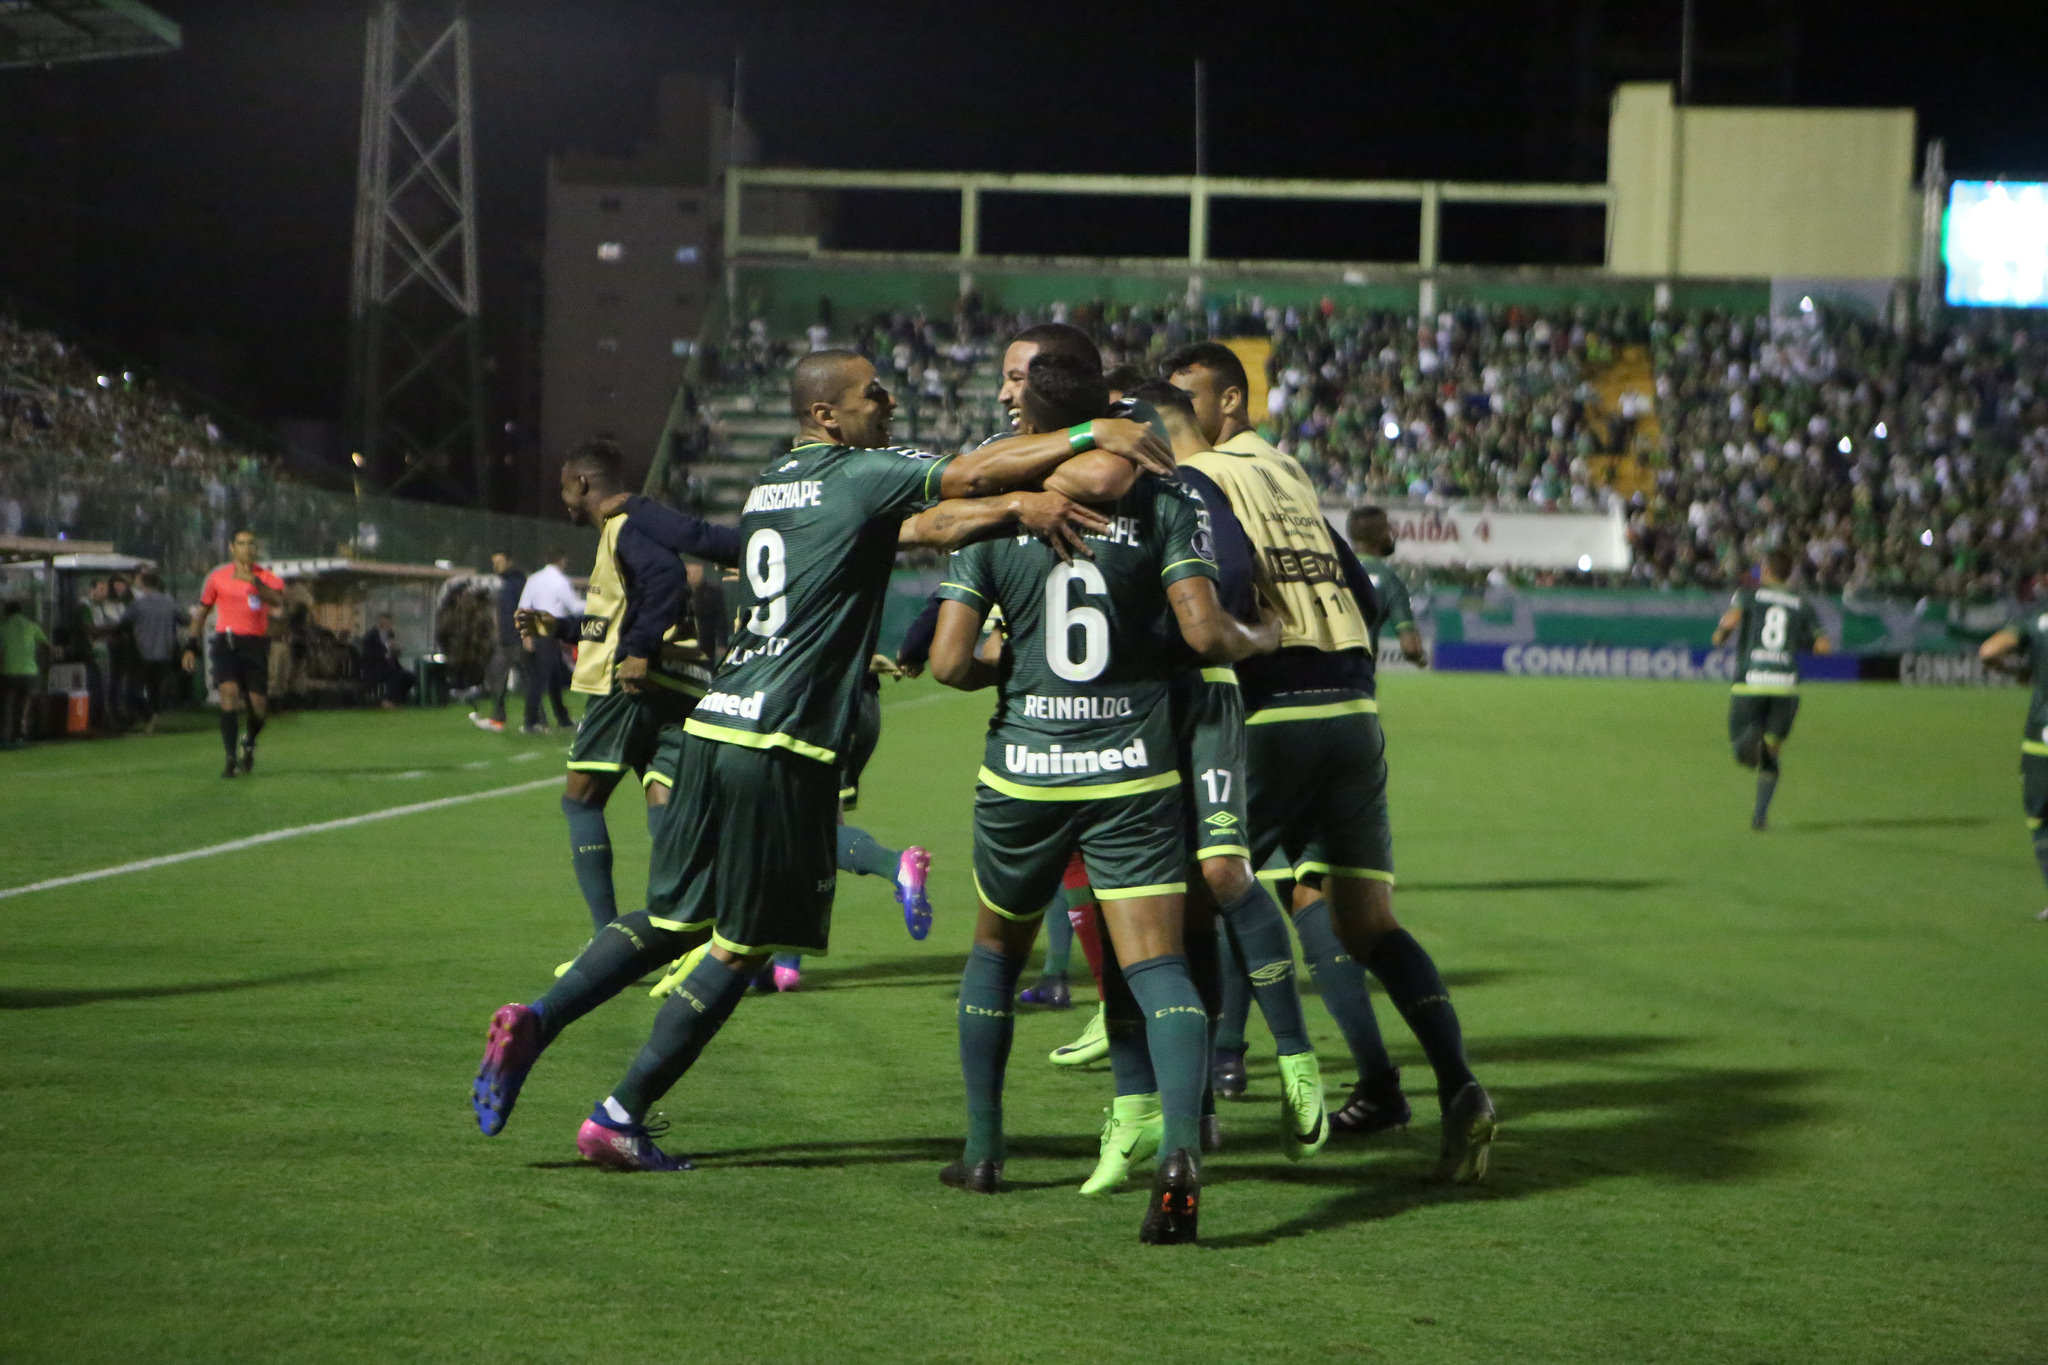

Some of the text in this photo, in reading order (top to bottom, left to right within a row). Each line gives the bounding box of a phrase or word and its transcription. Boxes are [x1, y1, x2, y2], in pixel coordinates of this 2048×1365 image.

[746, 528, 787, 637] 9
[1046, 559, 1109, 682] 6
[1761, 605, 1787, 650] 8
[695, 689, 765, 720] med
[1024, 694, 1132, 720] REINALDO
[1005, 738, 1148, 775] Unimed
[1201, 769, 1232, 803] 17
[965, 1003, 1006, 1017] CHA
